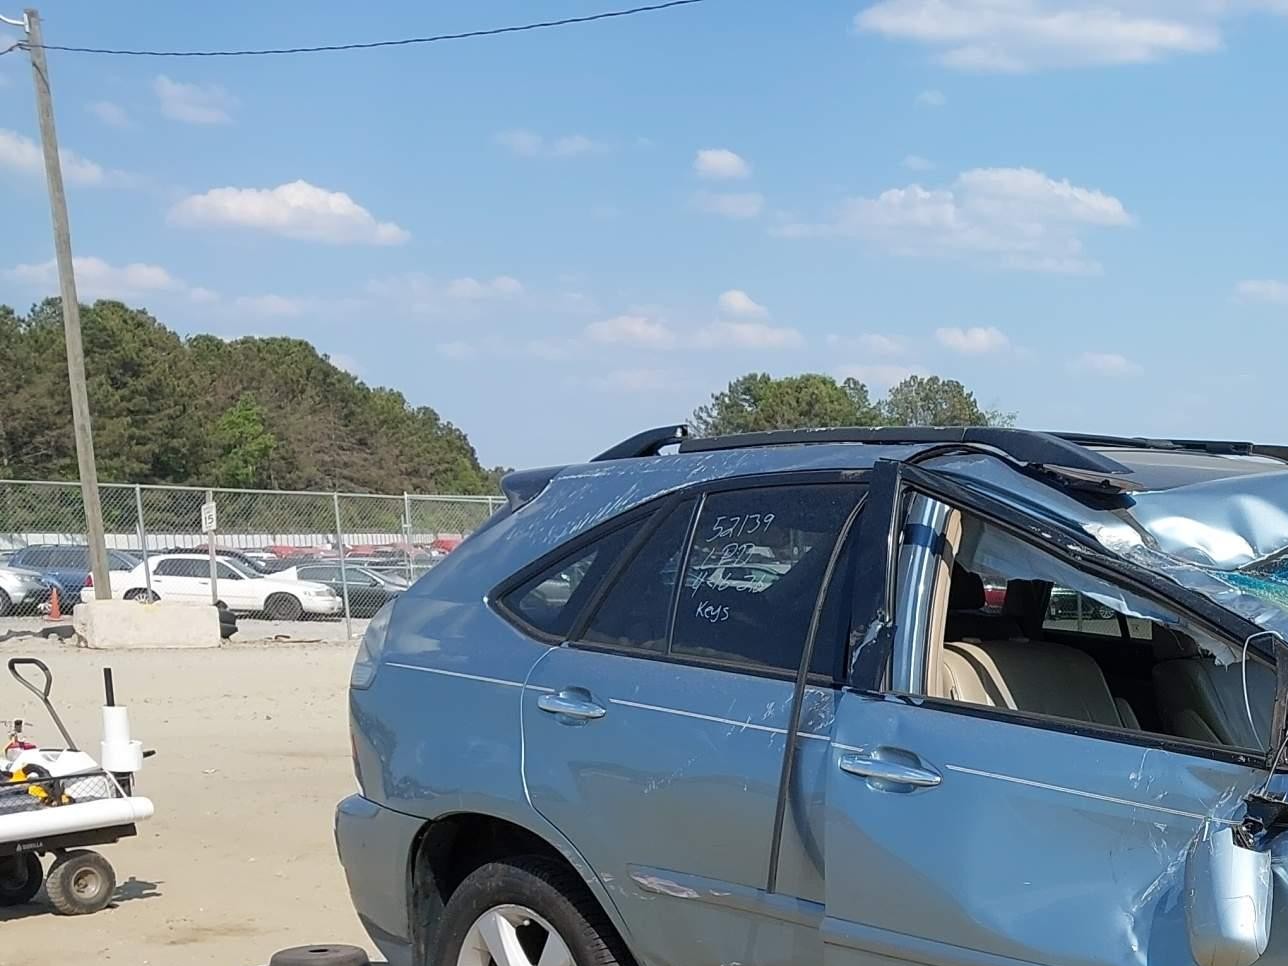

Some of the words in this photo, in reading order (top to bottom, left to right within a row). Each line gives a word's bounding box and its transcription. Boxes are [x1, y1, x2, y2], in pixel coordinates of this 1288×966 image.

[204, 513, 214, 526] 15
[705, 513, 775, 543] 52139
[695, 600, 730, 623] Keys
